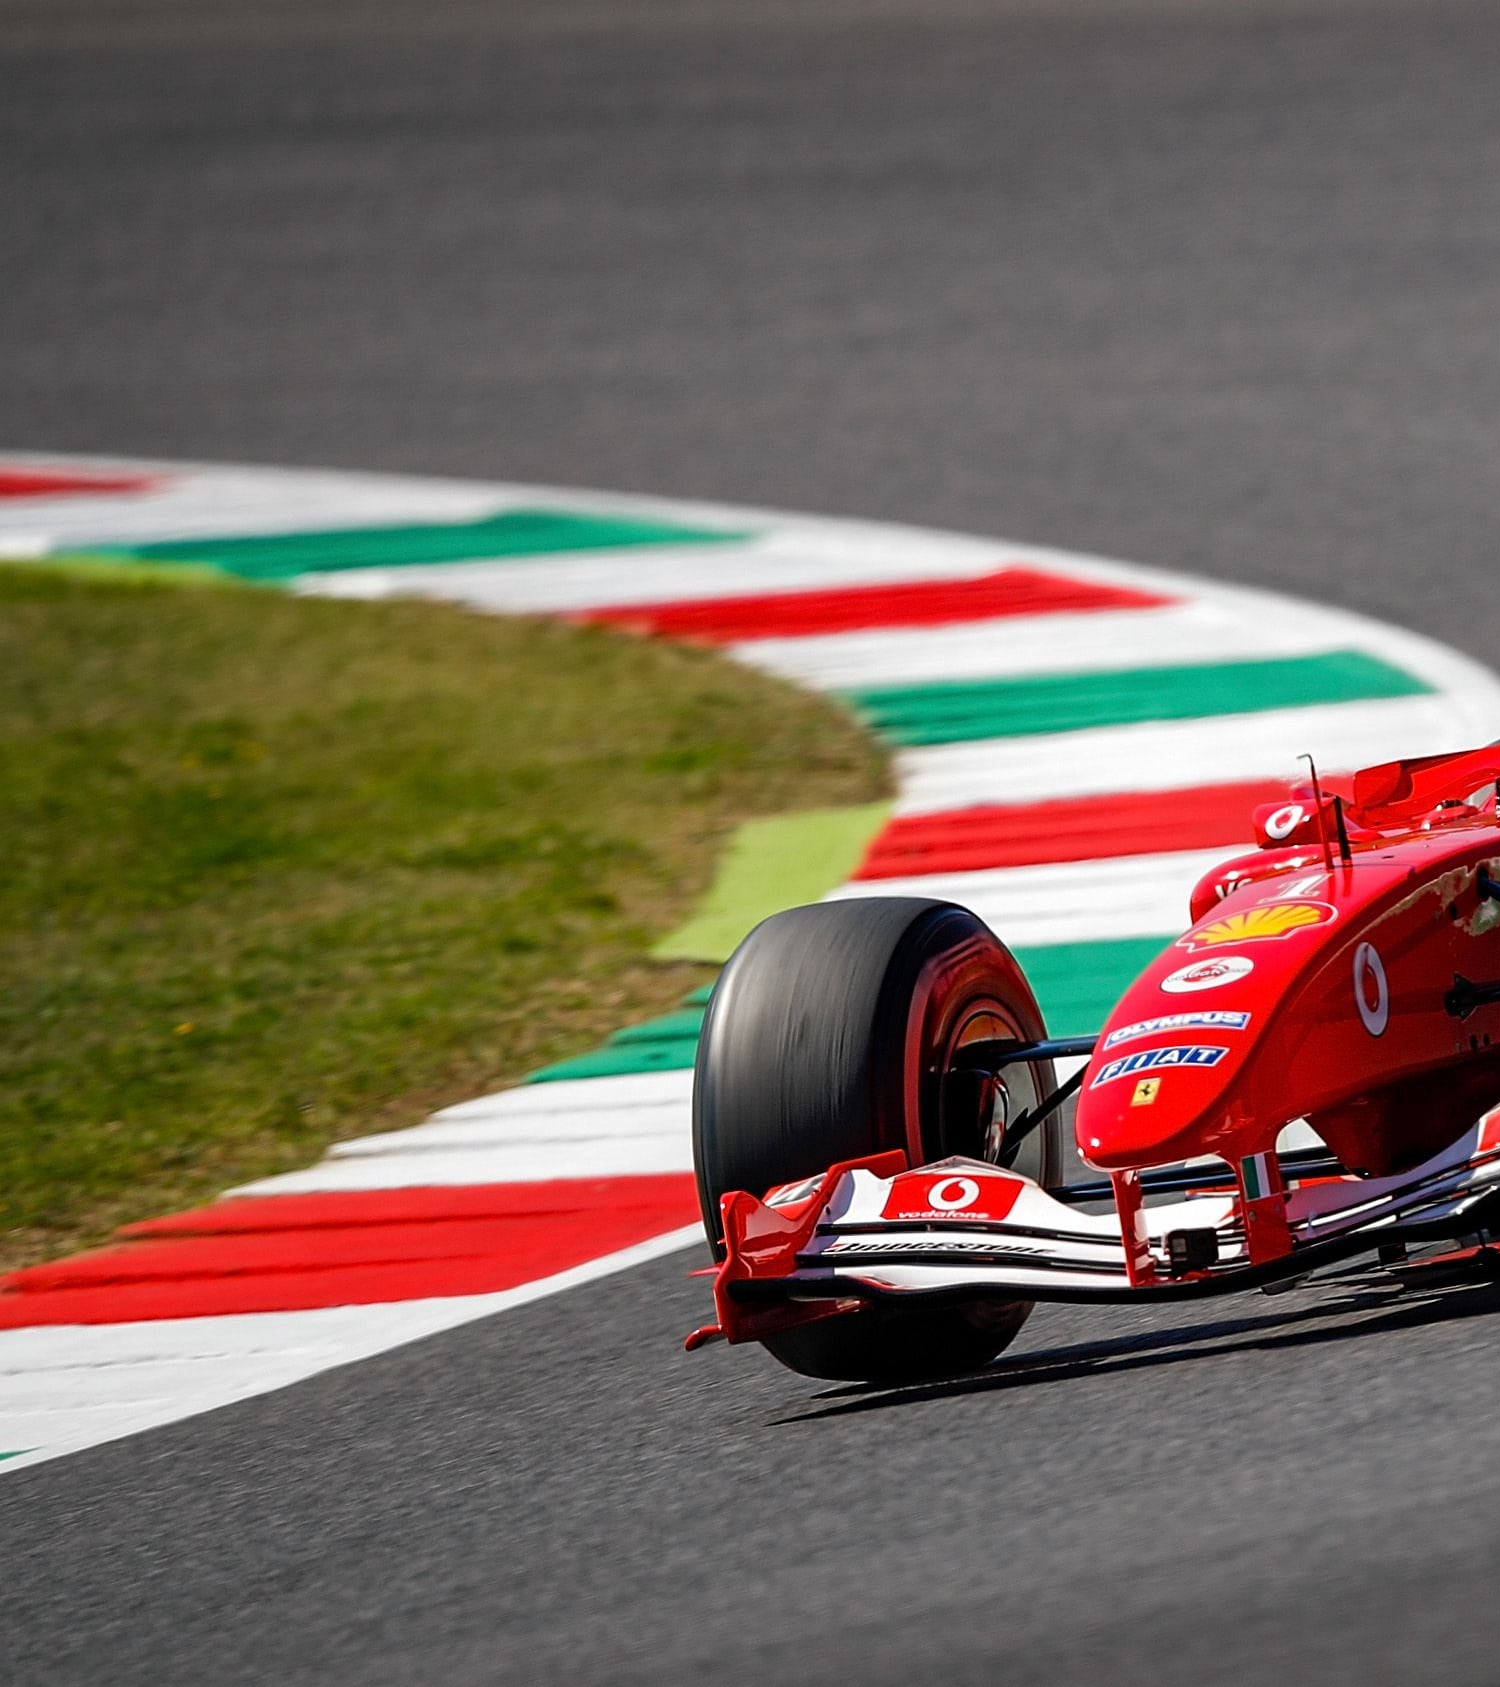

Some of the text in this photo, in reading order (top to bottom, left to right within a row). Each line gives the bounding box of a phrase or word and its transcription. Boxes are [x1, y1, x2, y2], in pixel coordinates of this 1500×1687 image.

[1110, 1012, 1244, 1042] OLYMPUS
[1102, 1049, 1217, 1080] FIAT
[898, 1209, 990, 1220] vodafone
